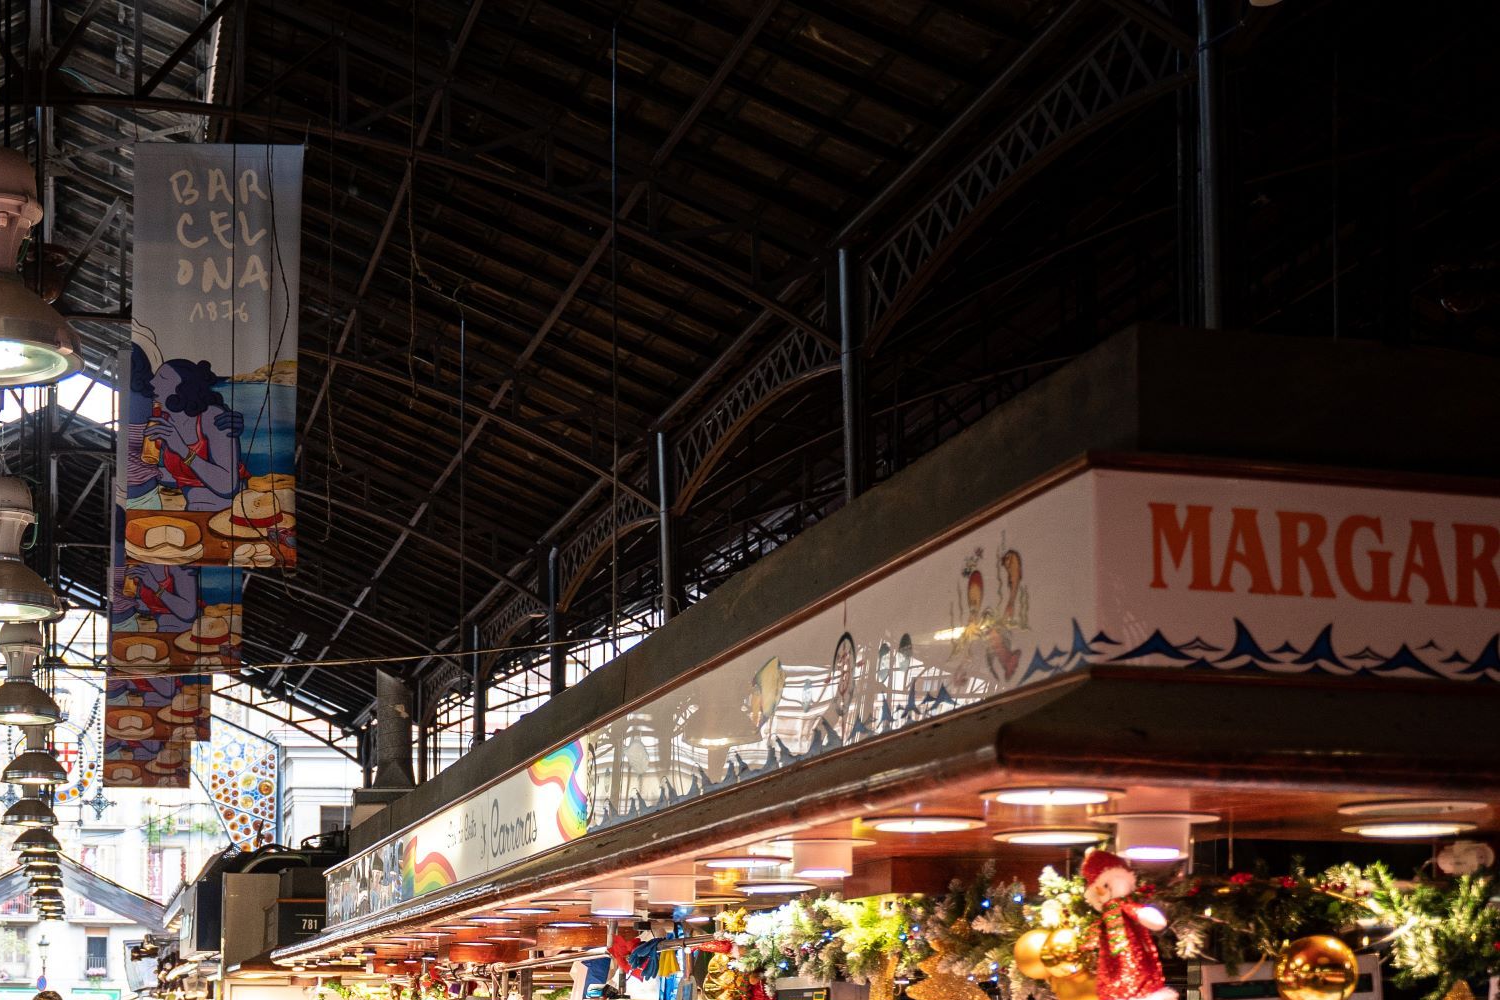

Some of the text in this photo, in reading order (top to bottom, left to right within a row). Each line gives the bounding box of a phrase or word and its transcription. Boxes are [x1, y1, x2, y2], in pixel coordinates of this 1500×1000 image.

[169, 168, 268, 205] BAR
[176, 210, 268, 249] CEL
[177, 254, 269, 293] ONA
[189, 301, 249, 323] 1876
[1148, 501, 1500, 610] MARGAR
[490, 798, 538, 858] Carreras
[302, 919, 318, 930] 781
